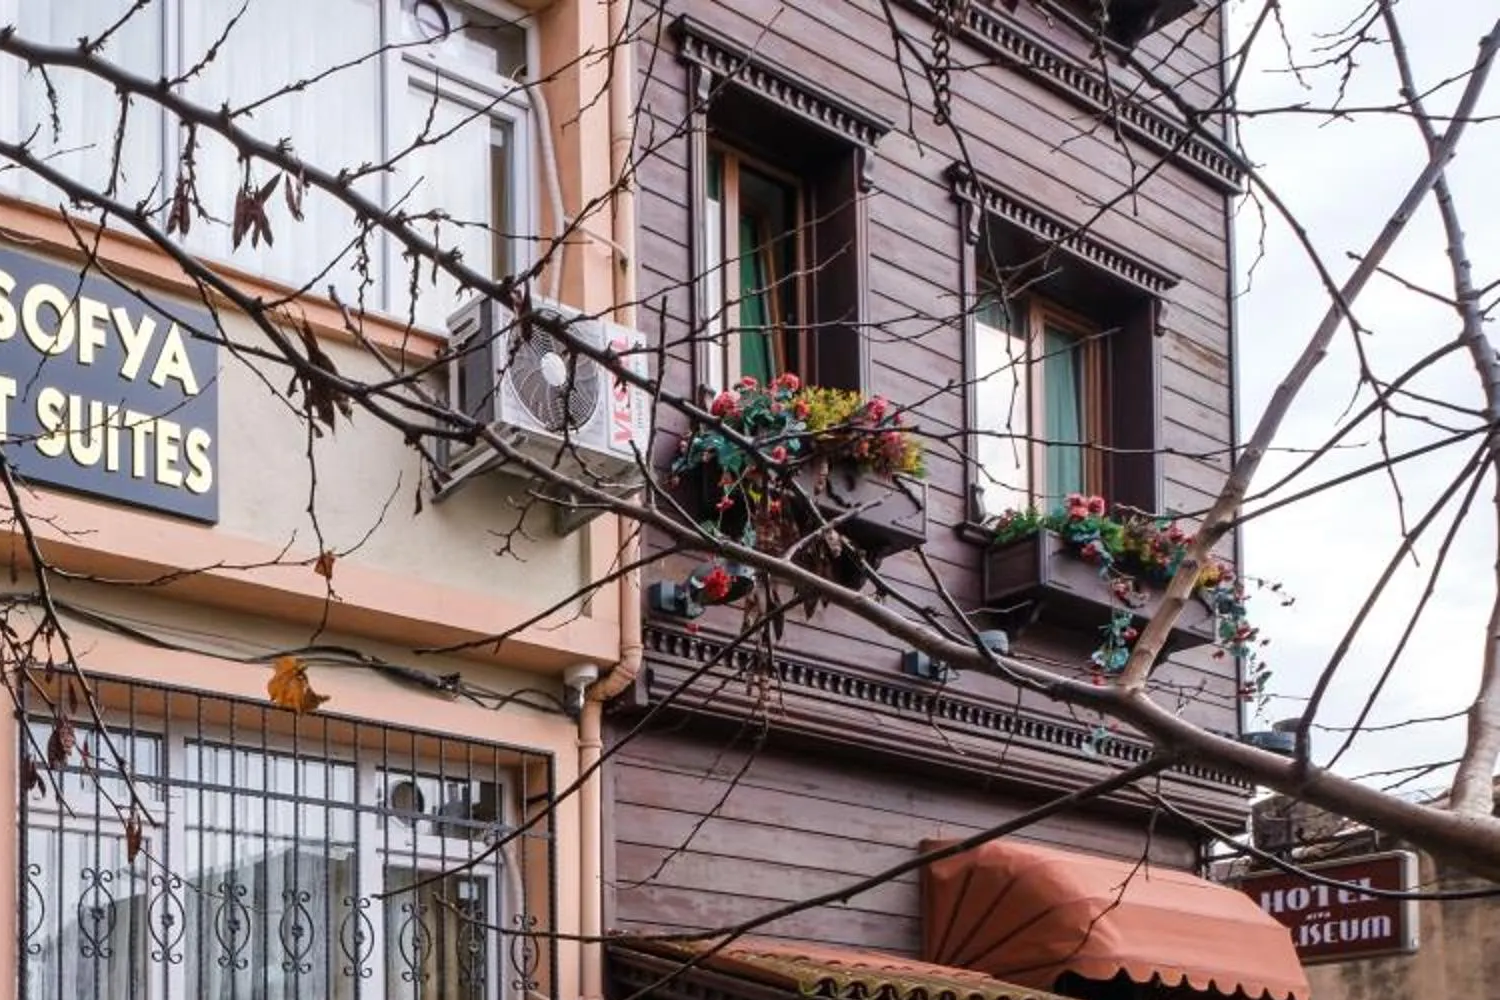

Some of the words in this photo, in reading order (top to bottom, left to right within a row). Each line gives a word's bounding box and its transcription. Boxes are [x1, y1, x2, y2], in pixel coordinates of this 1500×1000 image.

[35, 386, 213, 495] SUITES
[611, 334, 632, 442] VESL
[1295, 915, 1392, 947] SEUM
